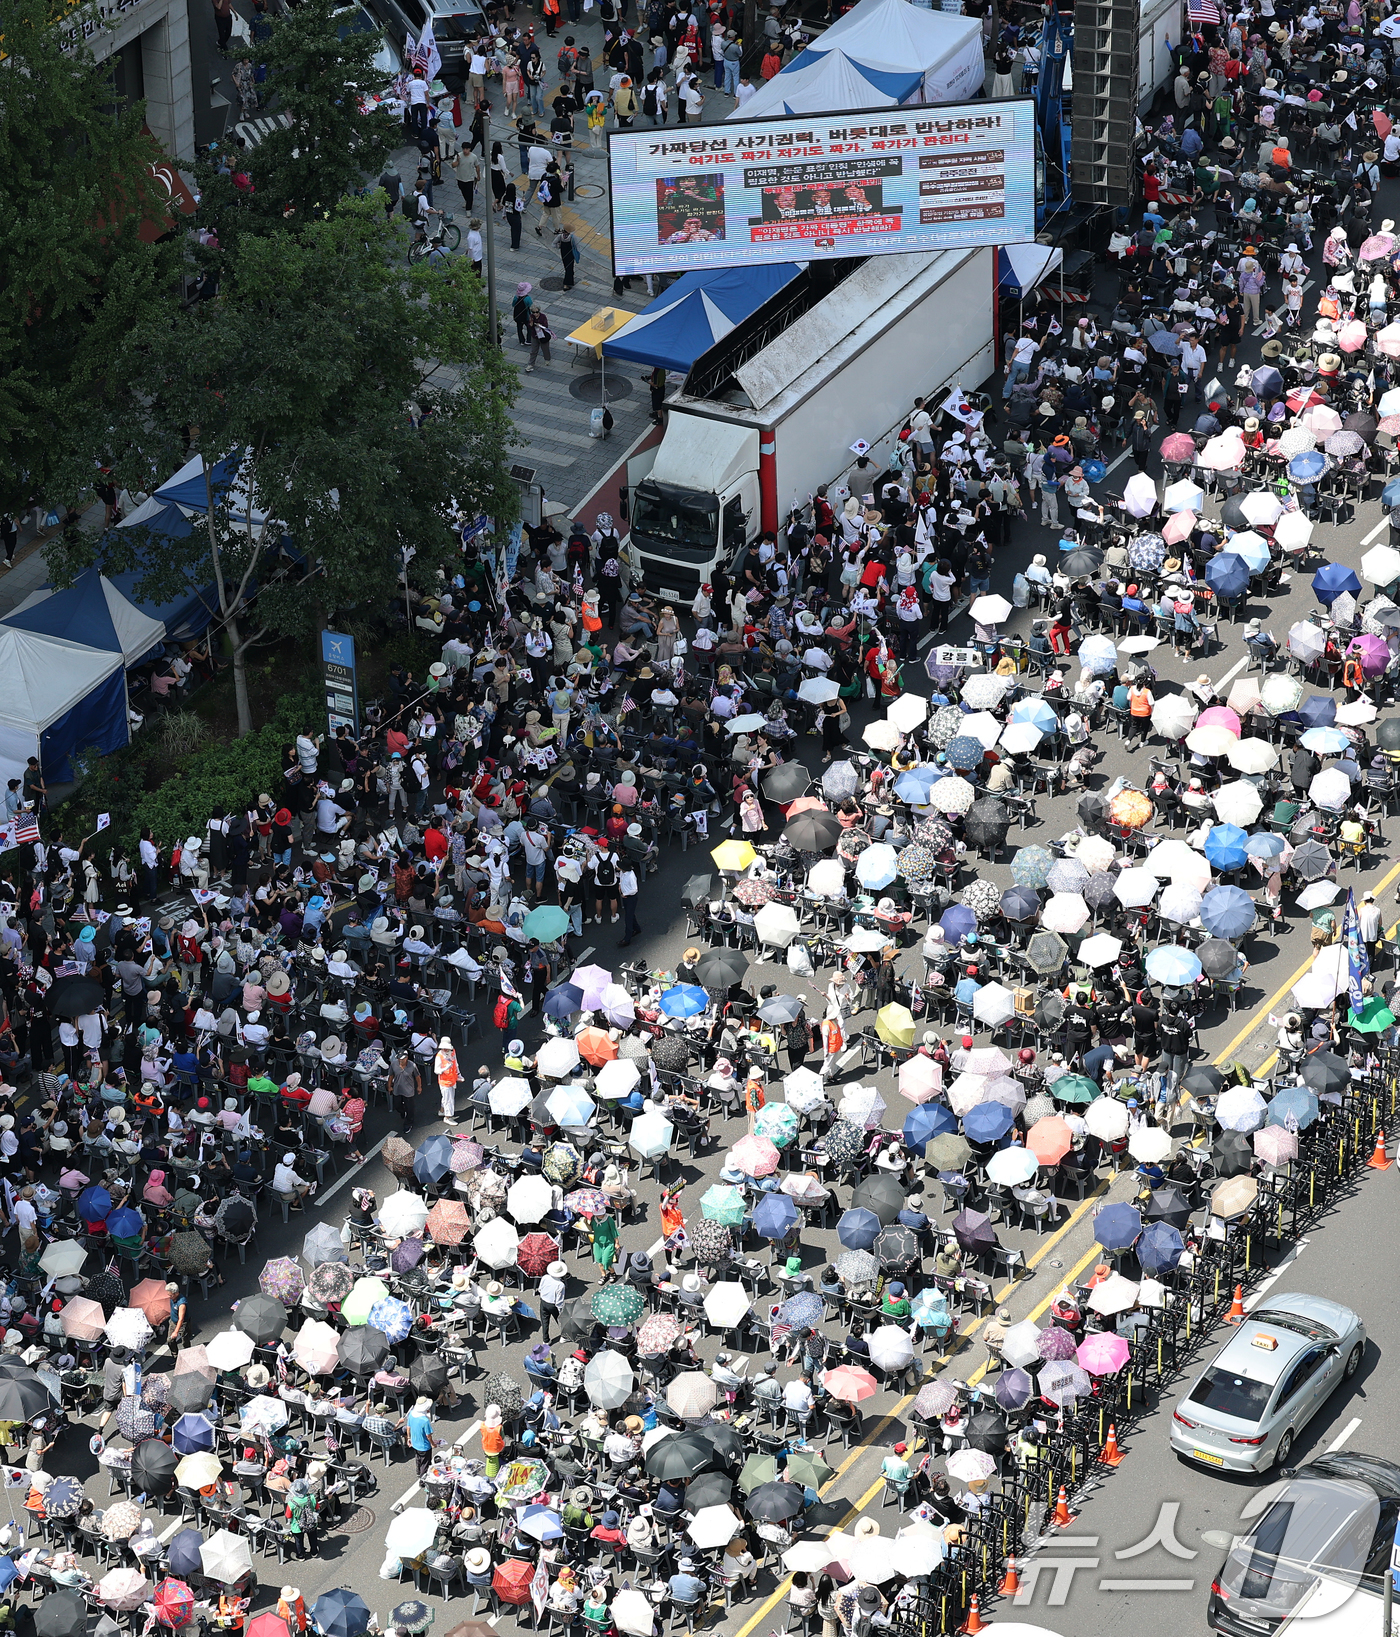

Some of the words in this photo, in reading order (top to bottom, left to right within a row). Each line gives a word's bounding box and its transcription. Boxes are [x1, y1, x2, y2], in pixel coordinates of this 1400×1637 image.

[649, 138, 728, 156] 가짜당선
[735, 132, 821, 148] 사기권력,
[916, 115, 1002, 134] 반납하라!
[689, 152, 736, 165] 여기도
[741, 150, 772, 161] 짜가
[778, 146, 824, 158] 저기도
[872, 138, 918, 150] 짜가가
[924, 132, 970, 146] 판친다
[780, 174, 800, 183] 것도
[803, 172, 834, 181] 아니고
[942, 652, 968, 662] 강릉
[328, 664, 347, 676] 6701
